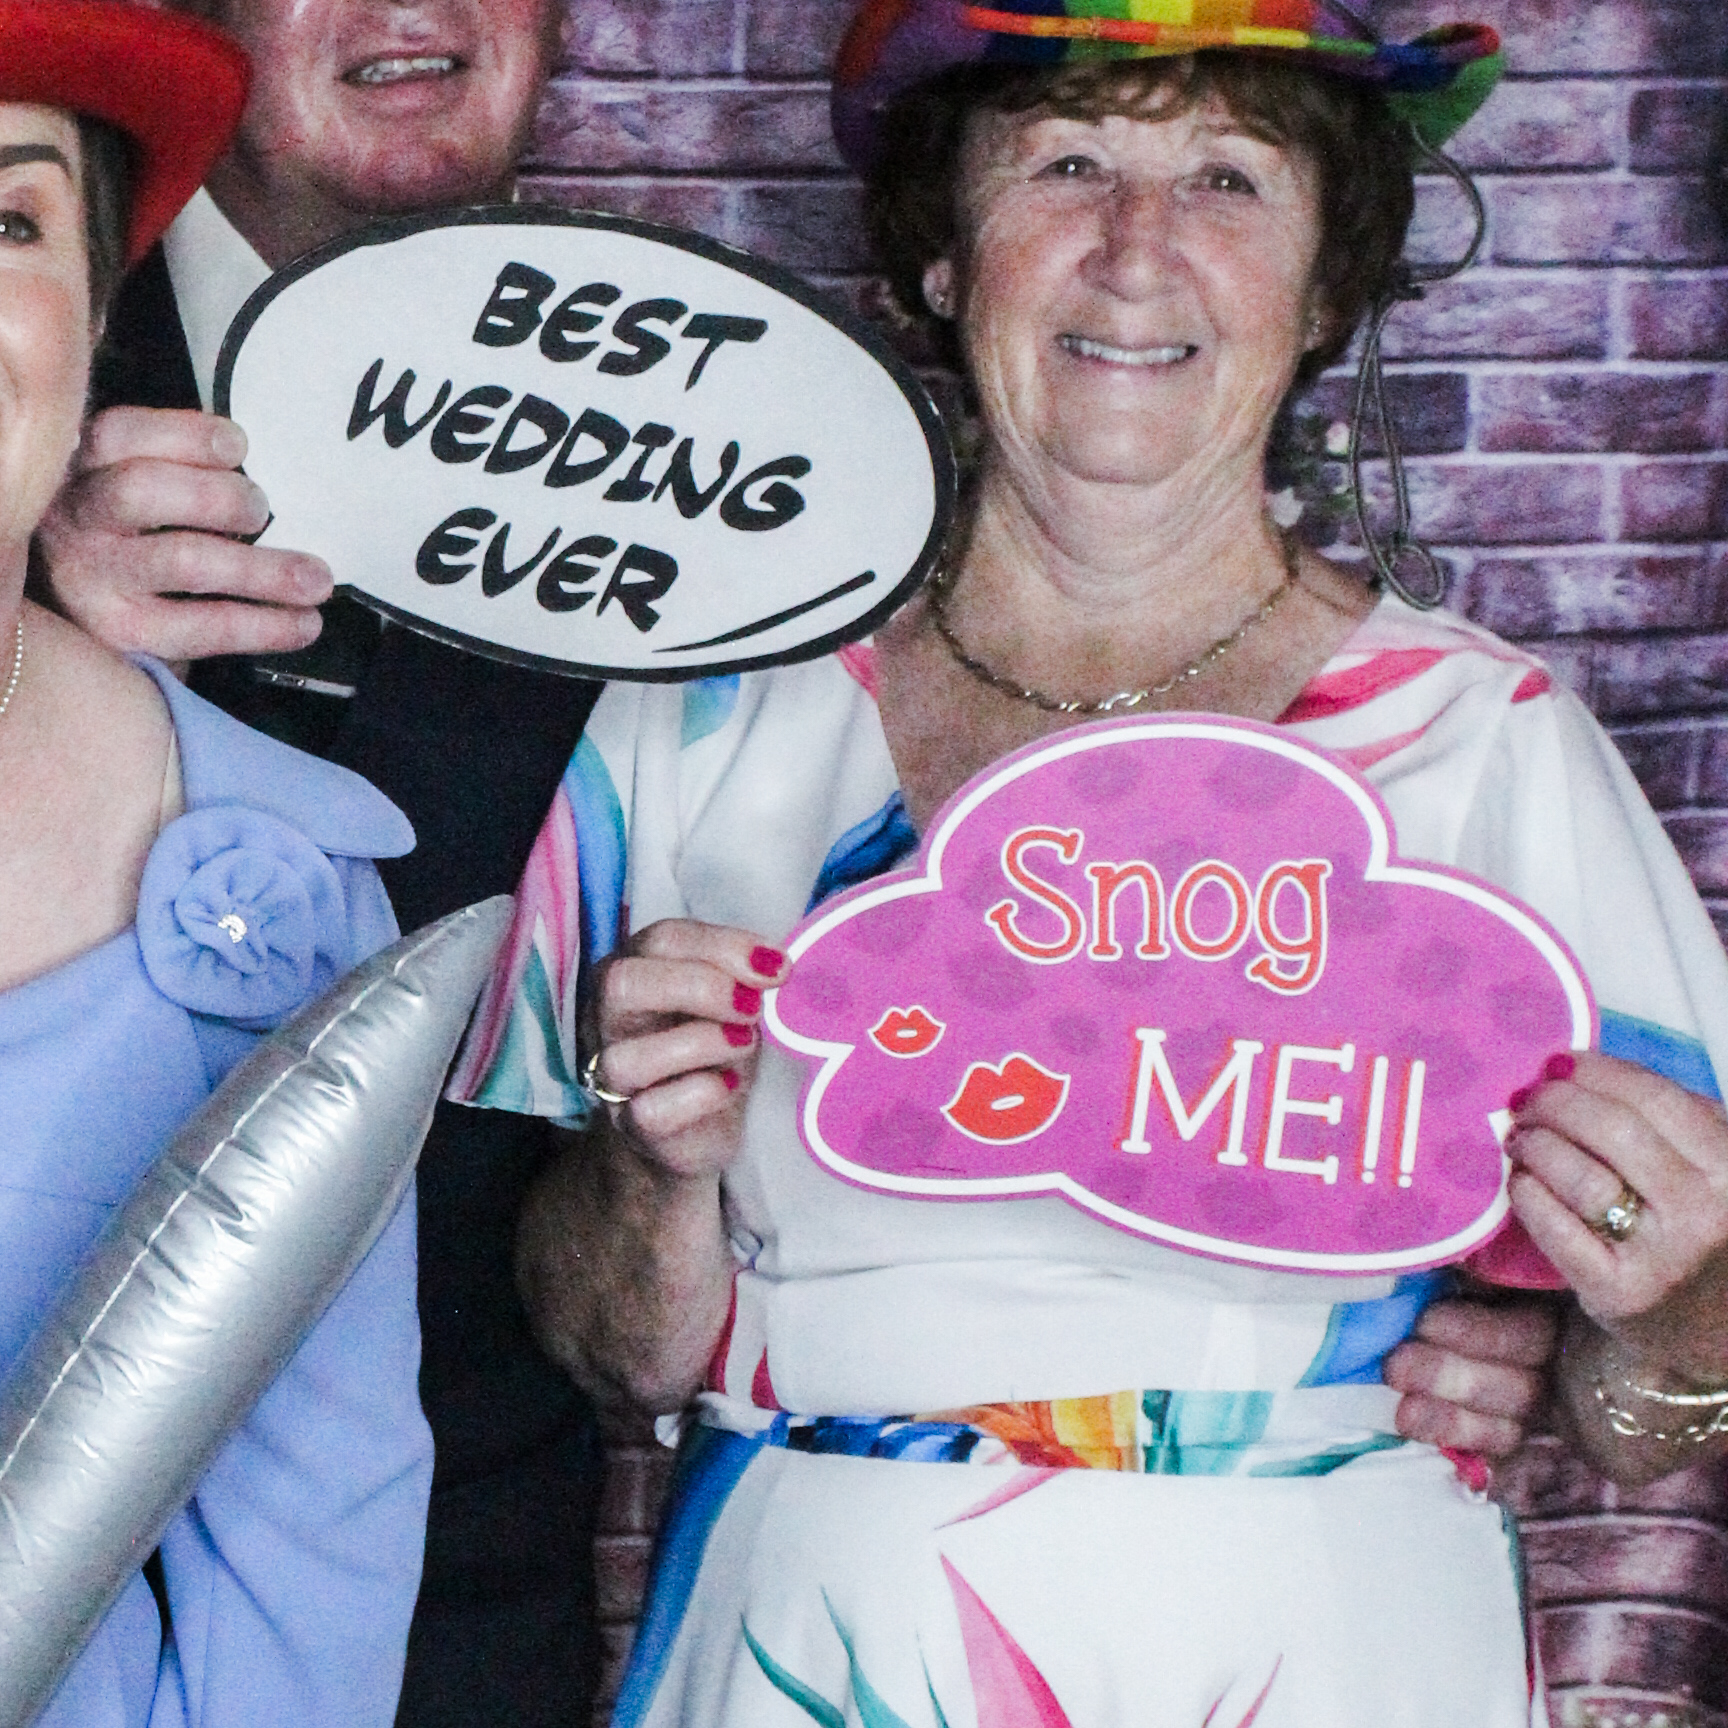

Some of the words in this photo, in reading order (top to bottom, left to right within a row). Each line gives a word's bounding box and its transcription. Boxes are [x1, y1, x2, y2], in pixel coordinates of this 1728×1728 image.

[472, 261, 768, 392] BEST
[346, 358, 812, 532] WEDDING
[415, 507, 679, 633] EVER
[986, 825, 1333, 995] Snog
[1114, 1027, 1426, 1189] ME!!
